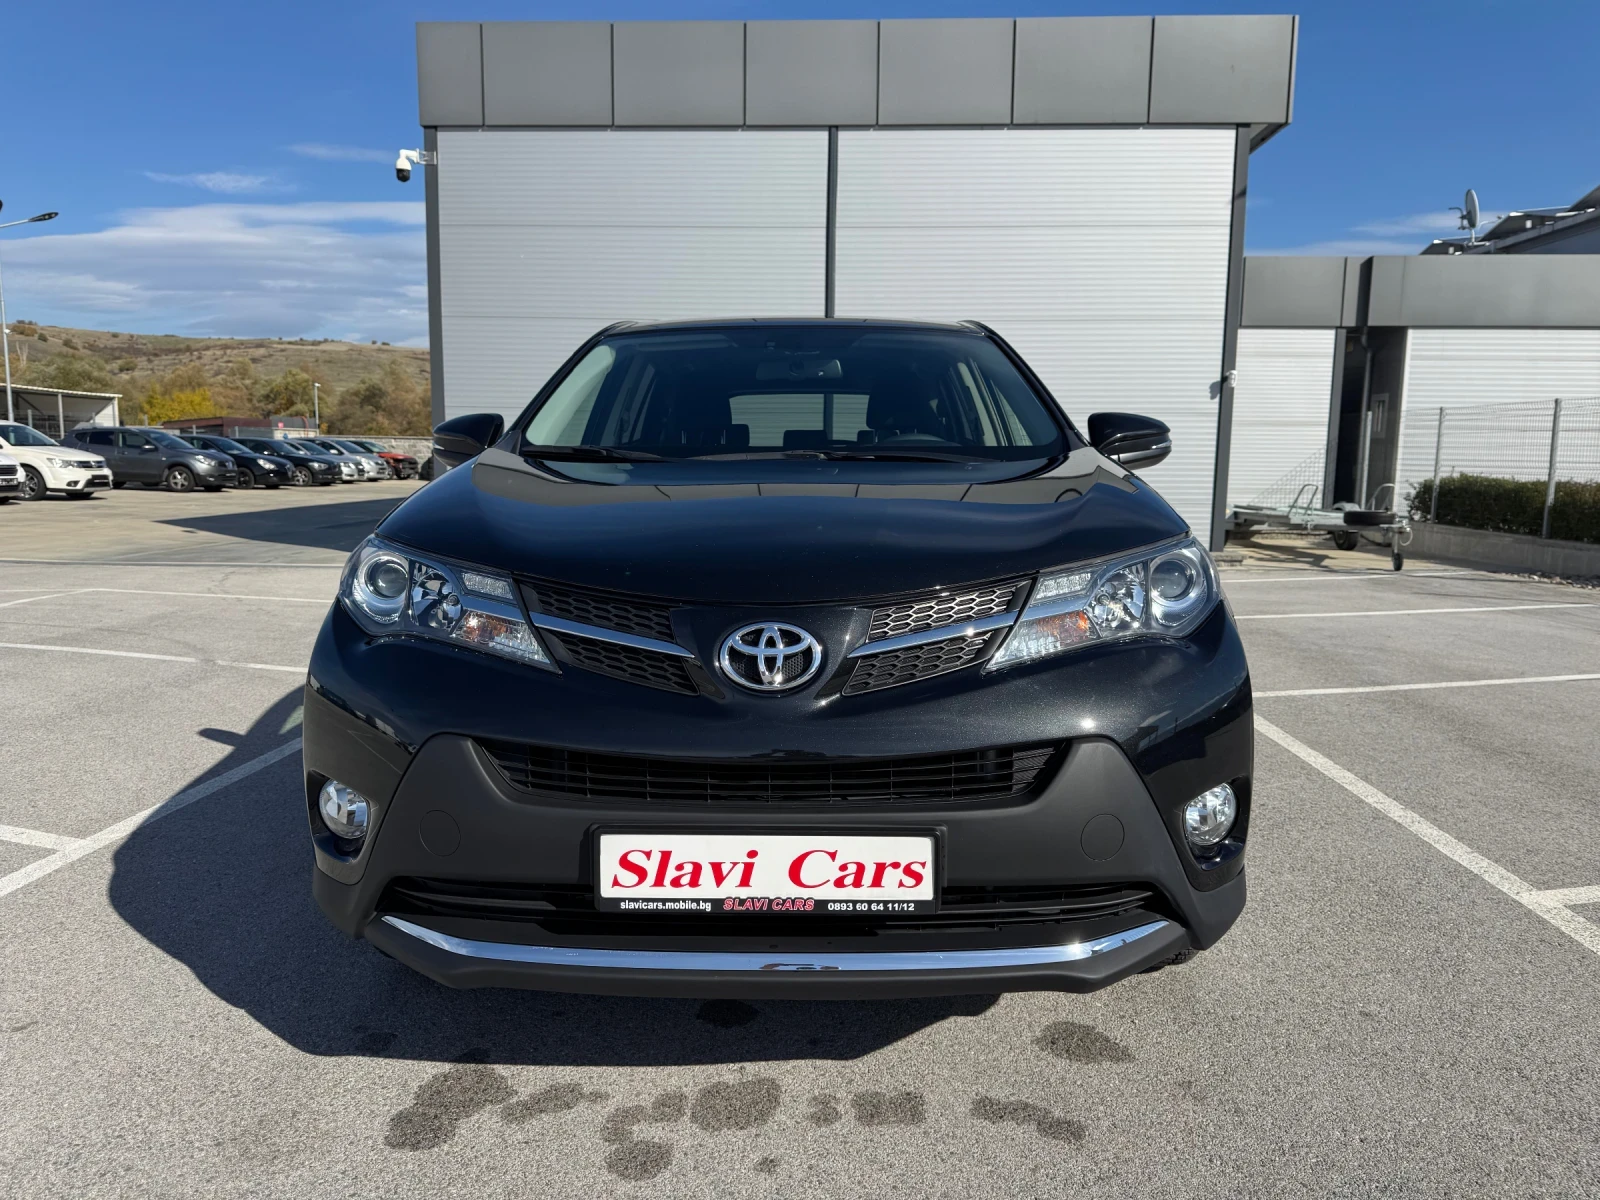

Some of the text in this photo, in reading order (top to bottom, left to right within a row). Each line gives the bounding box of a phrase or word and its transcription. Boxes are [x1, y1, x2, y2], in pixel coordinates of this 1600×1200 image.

[611, 849, 927, 889] Slavi Cars
[620, 900, 711, 912] slavicars.mobile.bg
[723, 898, 815, 911] SLAVI CARS
[827, 902, 915, 912] 0893 60 64 11/12
